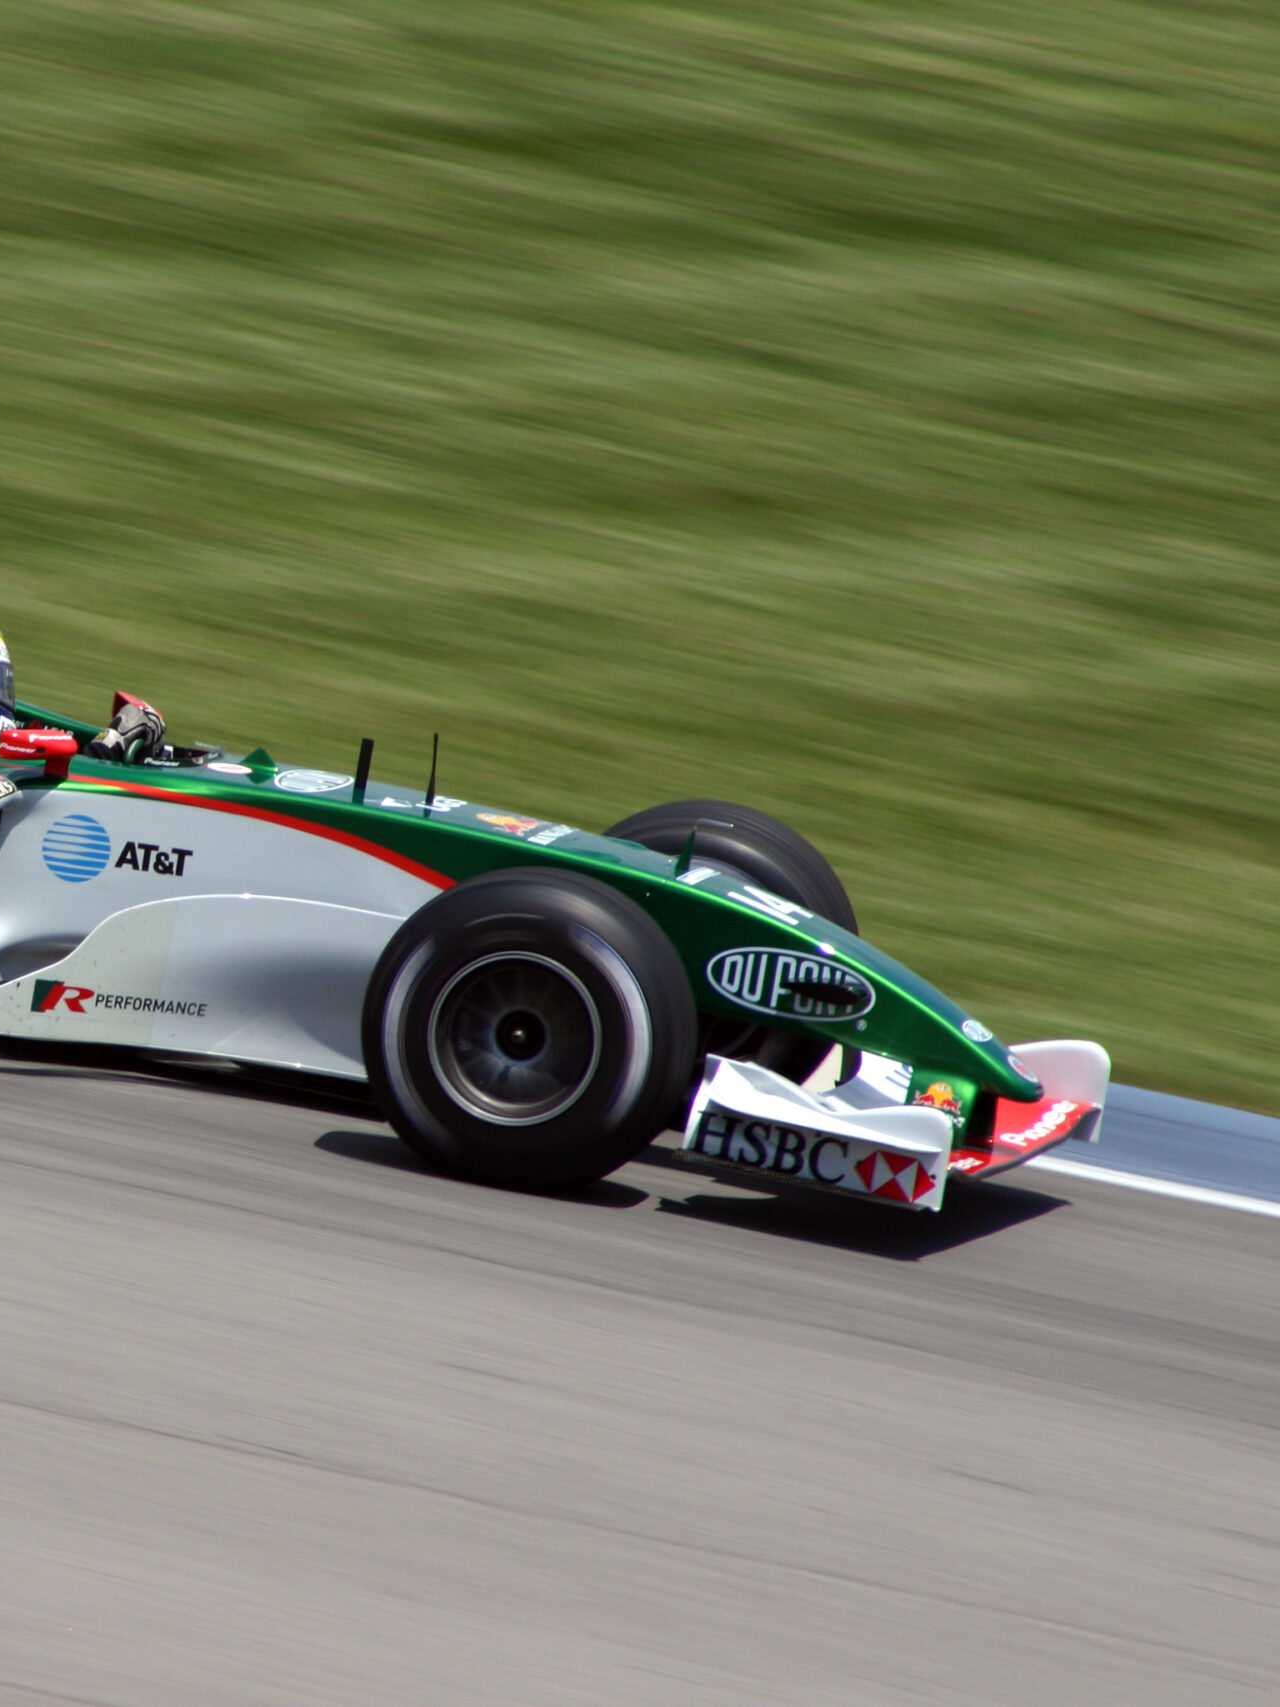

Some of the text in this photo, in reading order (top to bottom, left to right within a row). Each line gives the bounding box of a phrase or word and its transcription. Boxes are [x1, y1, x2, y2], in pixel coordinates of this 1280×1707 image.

[0, 742, 37, 754] Pioneer
[144, 757, 180, 768] Pioneer
[114, 841, 194, 877] AT&T
[727, 885, 814, 926] 14
[95, 993, 208, 1018] PERFORMANCE
[692, 1110, 850, 1185] HSBC
